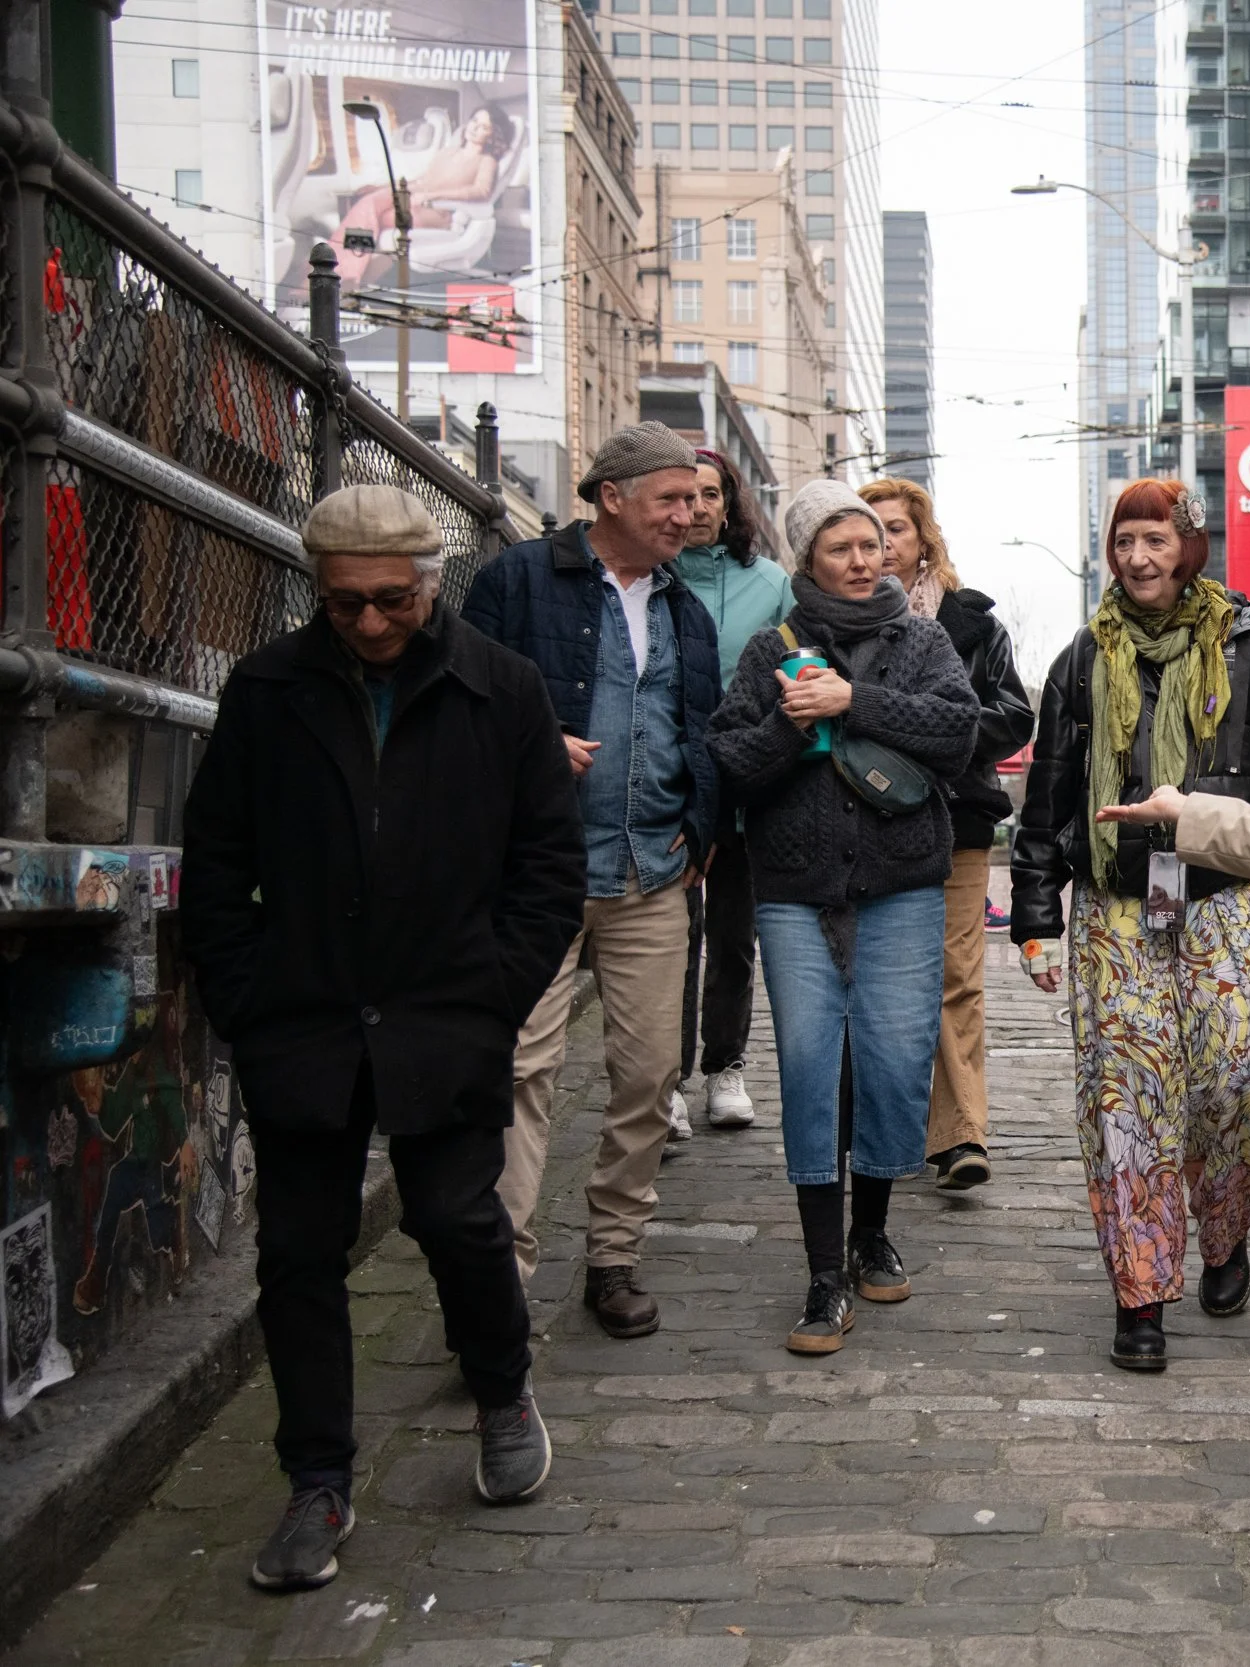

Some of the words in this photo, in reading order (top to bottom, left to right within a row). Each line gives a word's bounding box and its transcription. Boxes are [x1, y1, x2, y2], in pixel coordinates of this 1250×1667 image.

[284, 7, 328, 41] IT'S
[334, 8, 397, 43] HERE.
[286, 43, 396, 79] PREMIUM
[403, 47, 511, 83] ECONOMY
